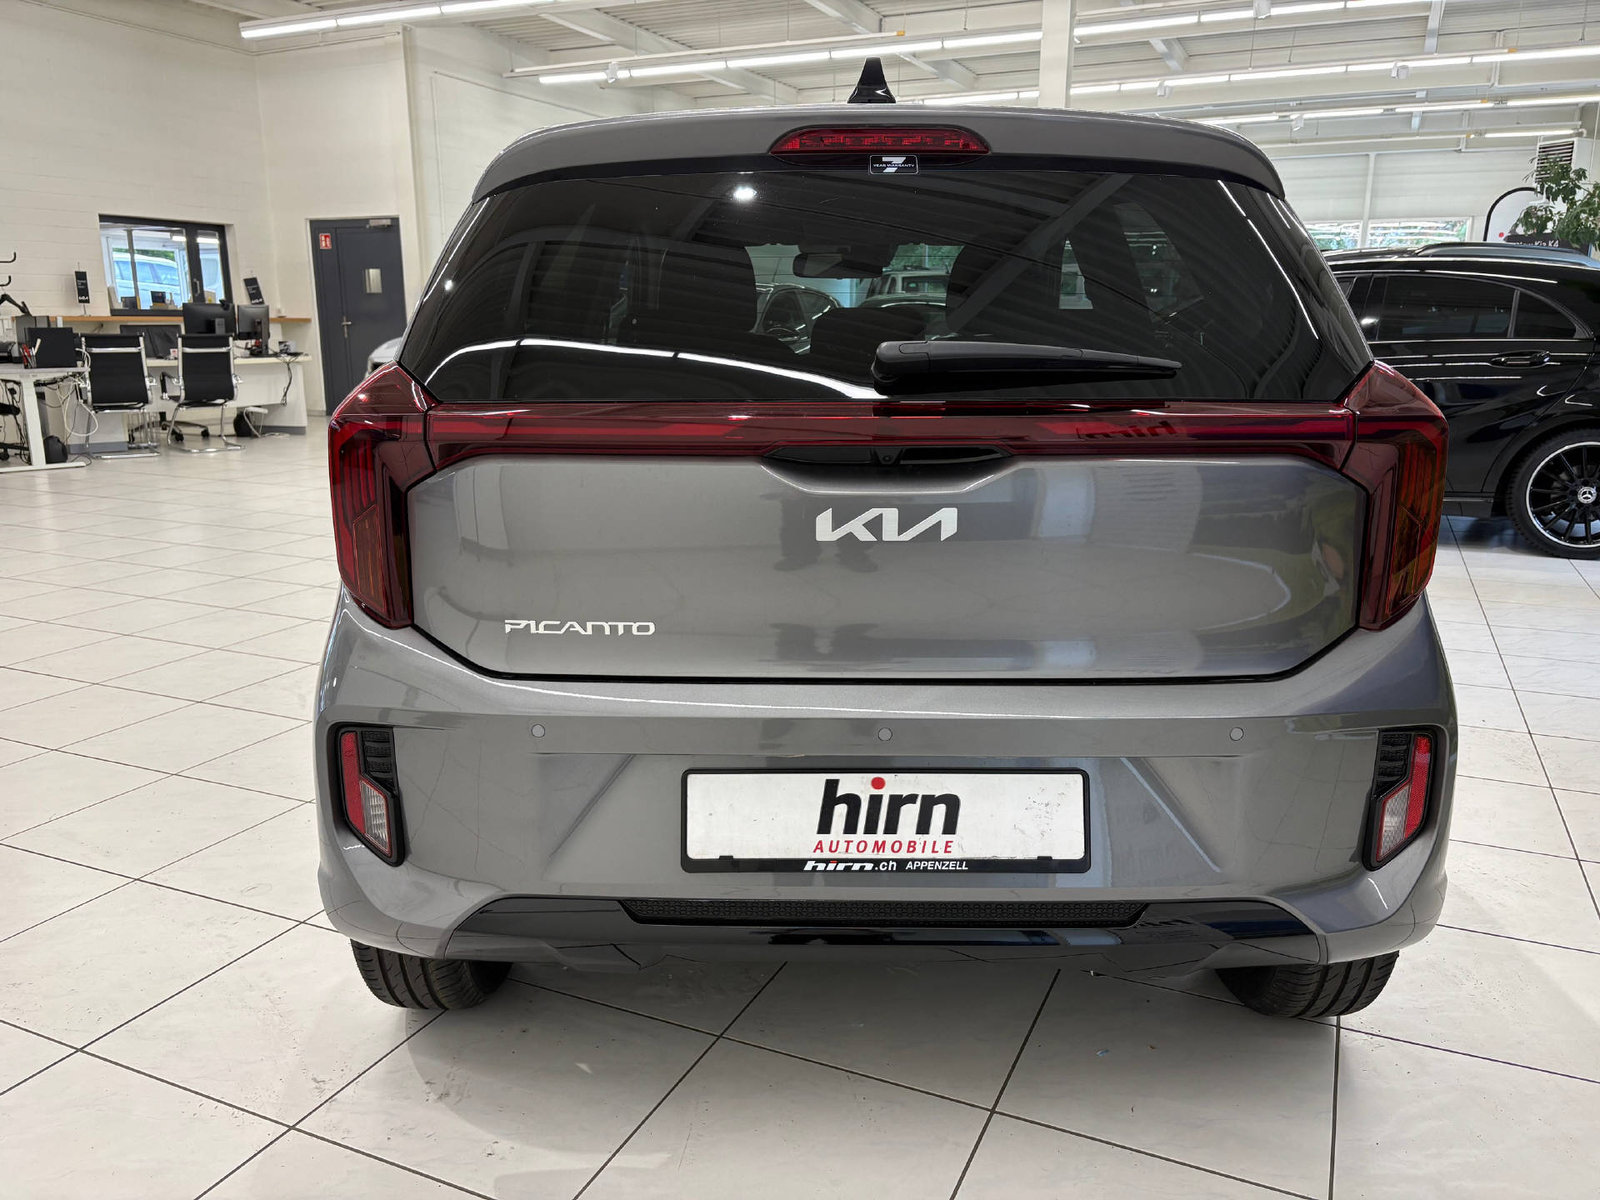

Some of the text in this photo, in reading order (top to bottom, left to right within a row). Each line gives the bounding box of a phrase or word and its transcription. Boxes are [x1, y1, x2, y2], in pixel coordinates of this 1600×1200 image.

[882, 157, 906, 173] 7
[816, 507, 958, 542] KIA
[504, 619, 656, 637] PICANTO
[816, 776, 962, 836] hirn
[812, 839, 955, 855] AUTOMOBILE
[803, 859, 969, 872] hirn.ch APPENZELL
